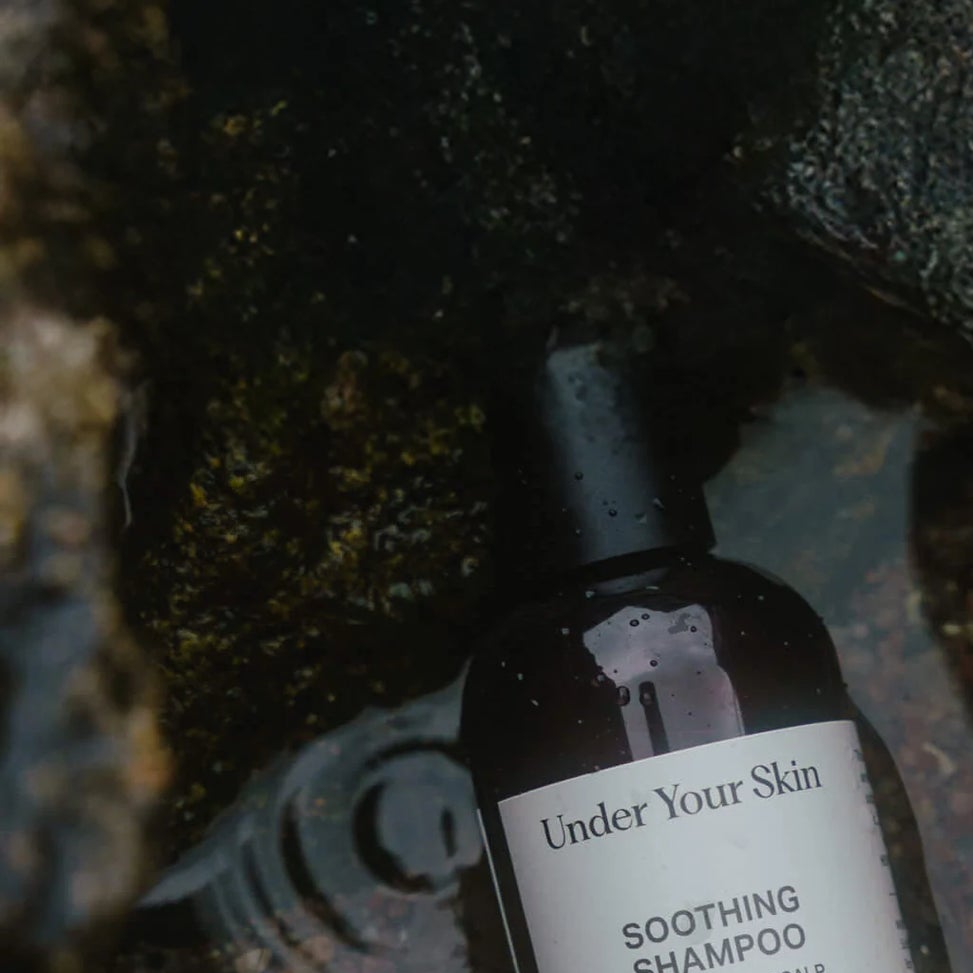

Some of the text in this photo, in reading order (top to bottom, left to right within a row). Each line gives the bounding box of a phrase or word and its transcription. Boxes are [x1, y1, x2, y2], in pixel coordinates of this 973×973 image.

[540, 759, 823, 850] Under Your Skin
[622, 885, 800, 949] SOOTHING
